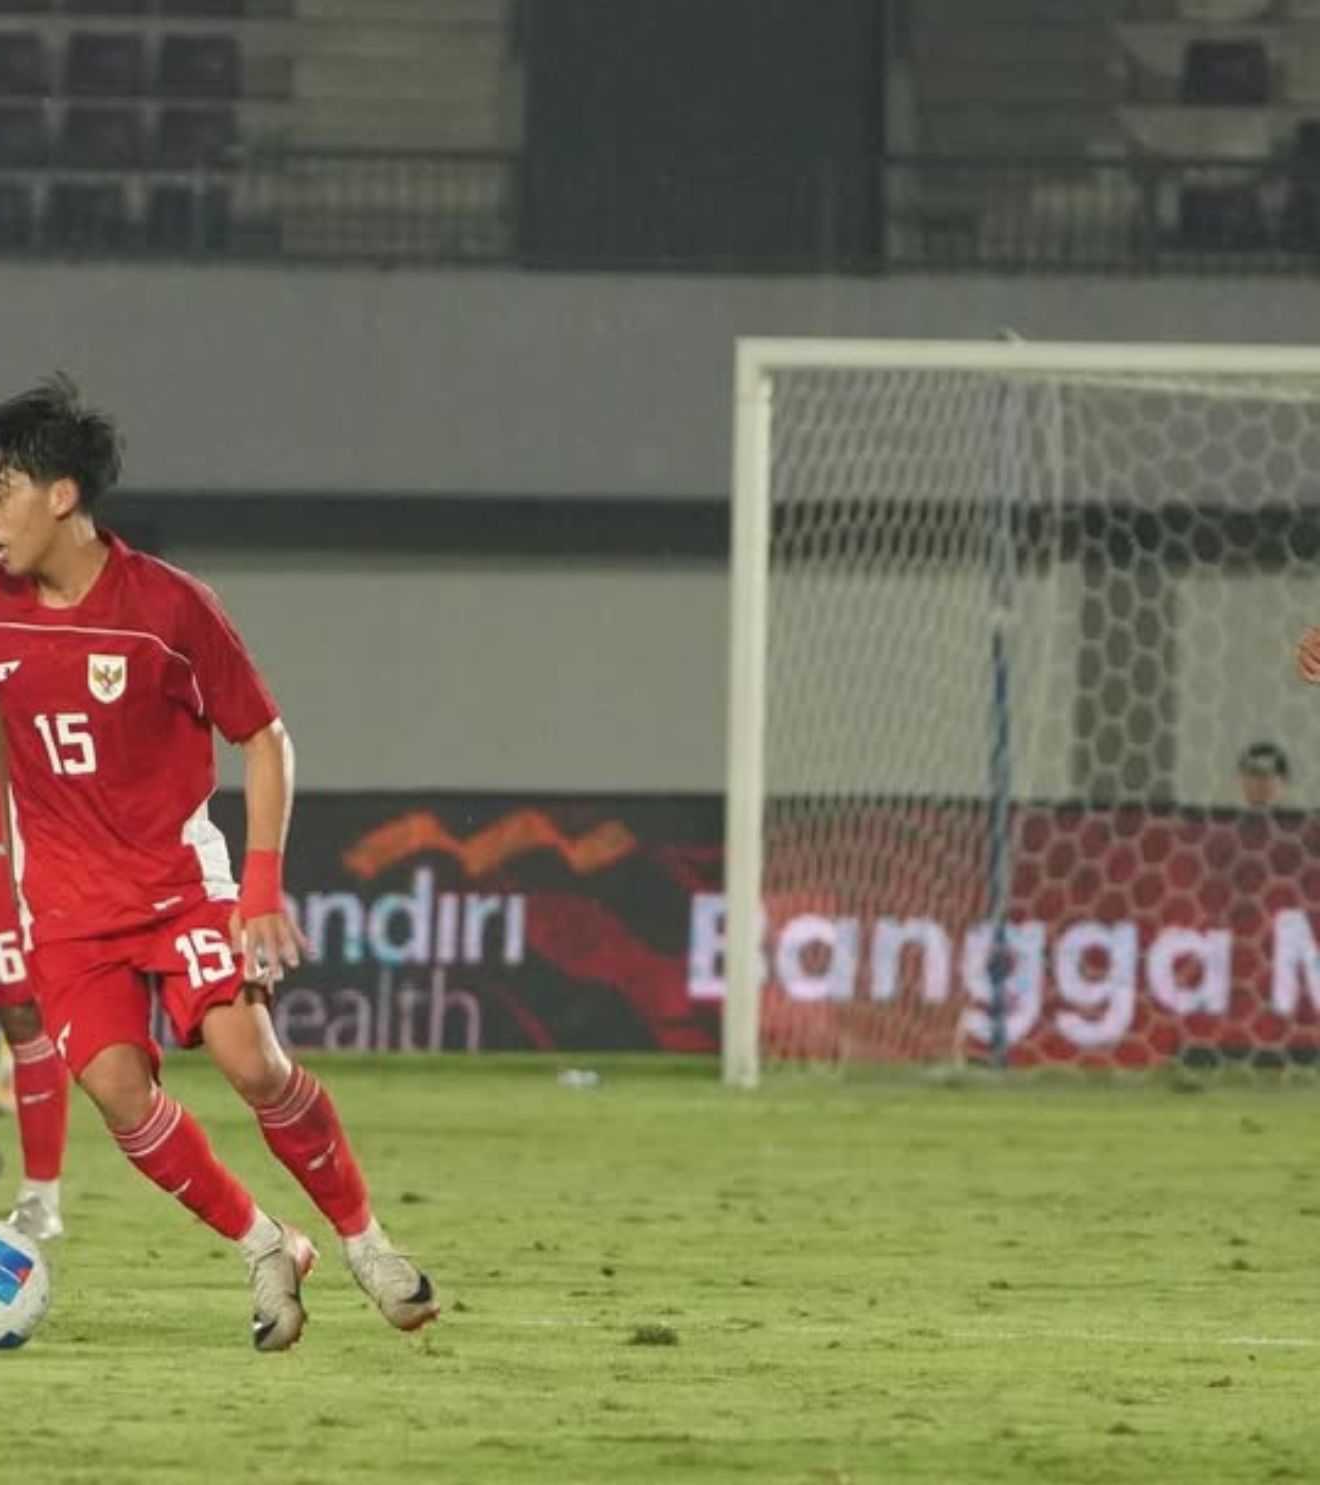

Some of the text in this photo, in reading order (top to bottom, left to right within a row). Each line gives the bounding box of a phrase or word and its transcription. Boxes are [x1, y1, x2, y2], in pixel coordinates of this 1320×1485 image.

[33, 712, 98, 776] 15
[174, 927, 237, 989] 15
[284, 865, 526, 968] ndiri
[276, 967, 480, 1051] ealth
[687, 891, 1234, 1048] Bangga
